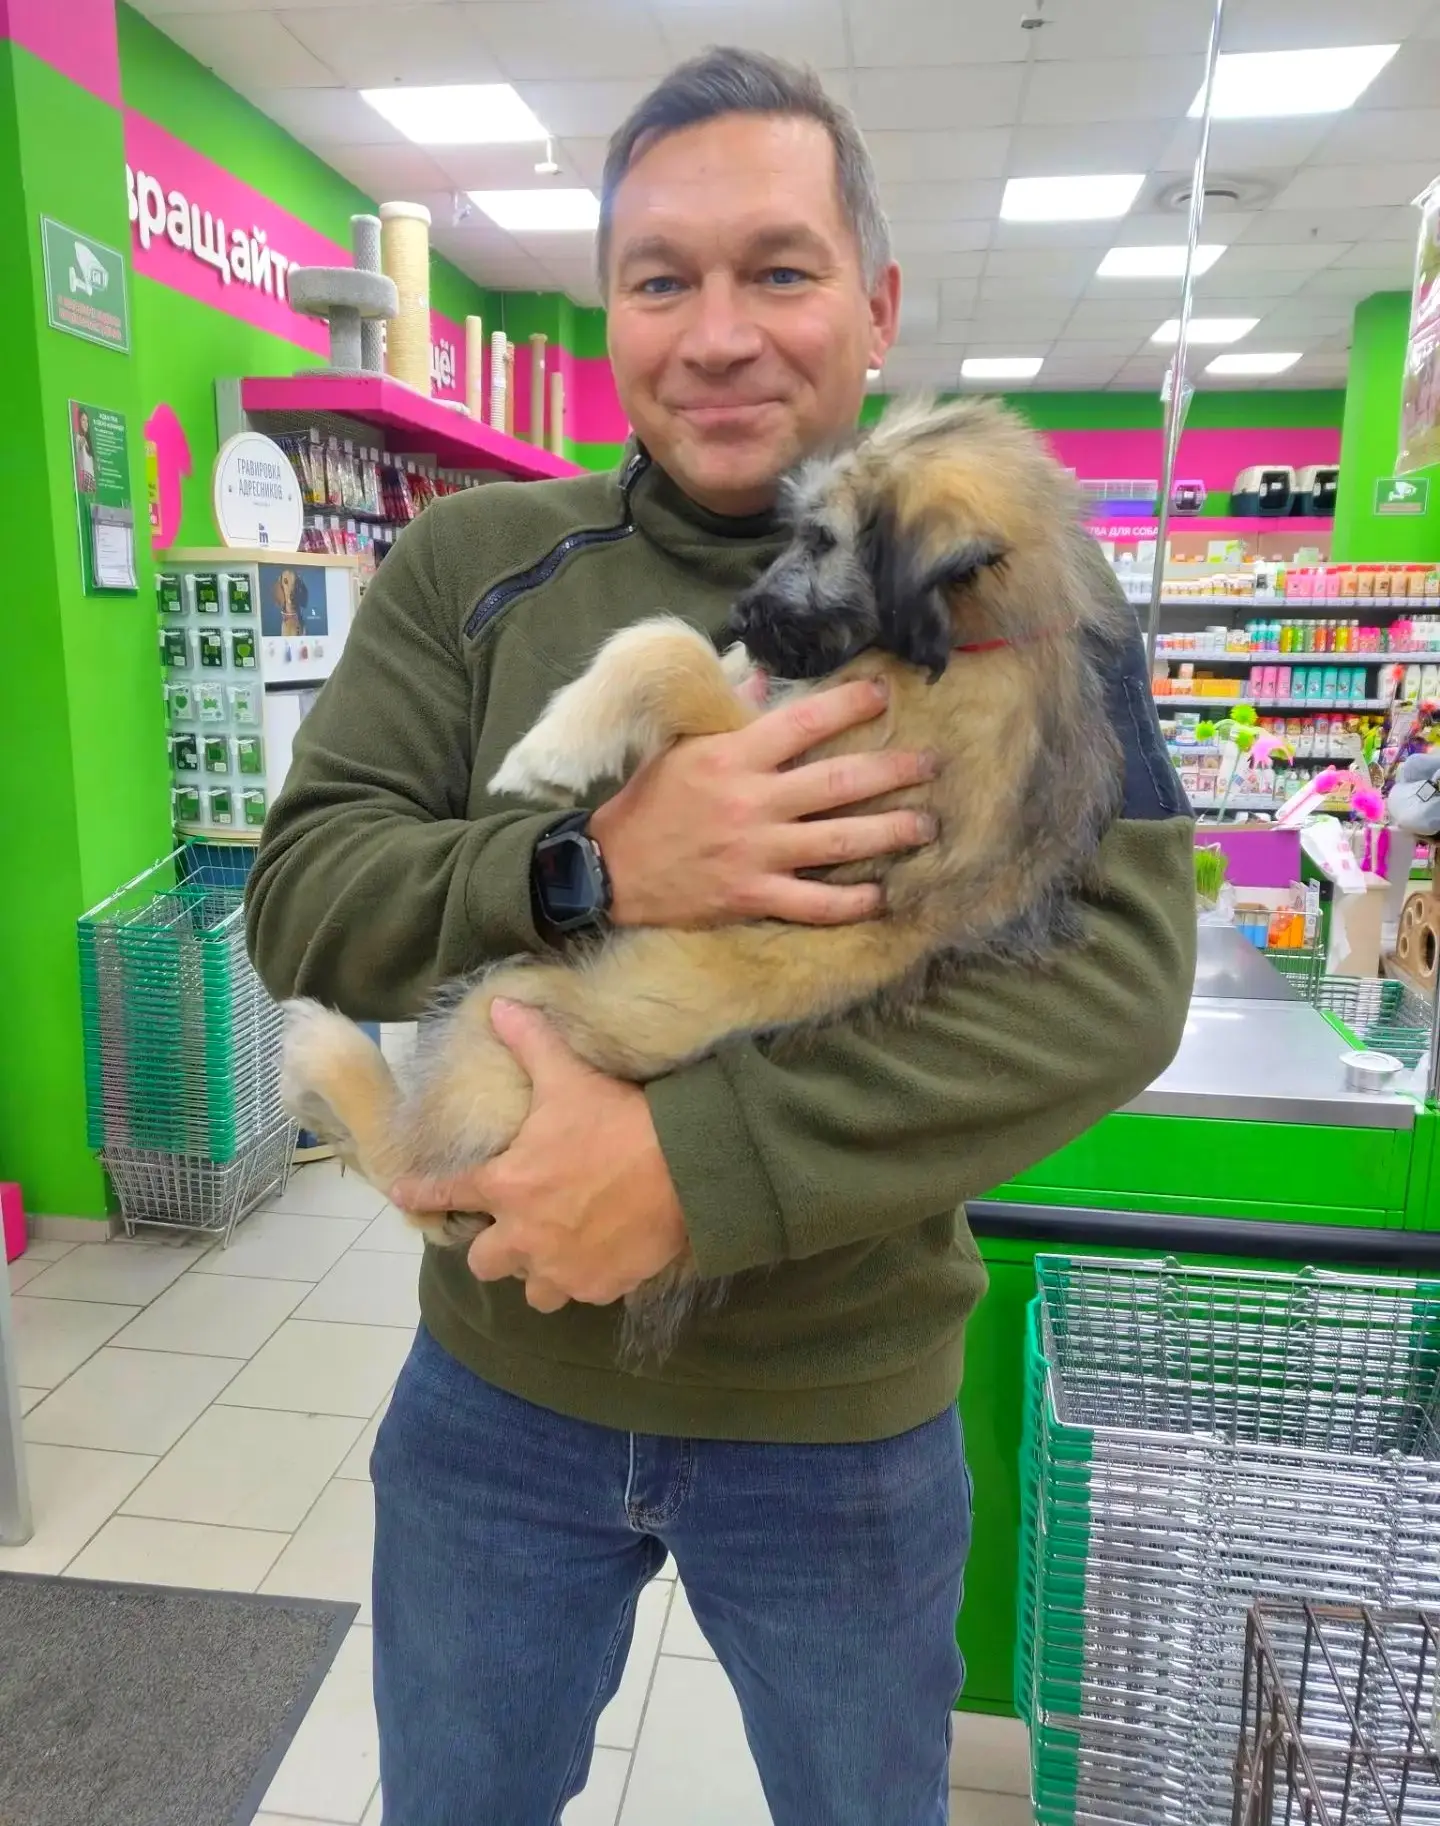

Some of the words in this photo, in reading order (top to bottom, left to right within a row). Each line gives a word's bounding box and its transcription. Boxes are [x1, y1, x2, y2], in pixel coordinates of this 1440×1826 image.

[126, 163, 300, 301] ращайт
[237, 458, 281, 480] ГРАВИРОВКА
[239, 479, 283, 500] АДРЕСНИКОВ
[1108, 526, 1131, 537] ДЛЯ
